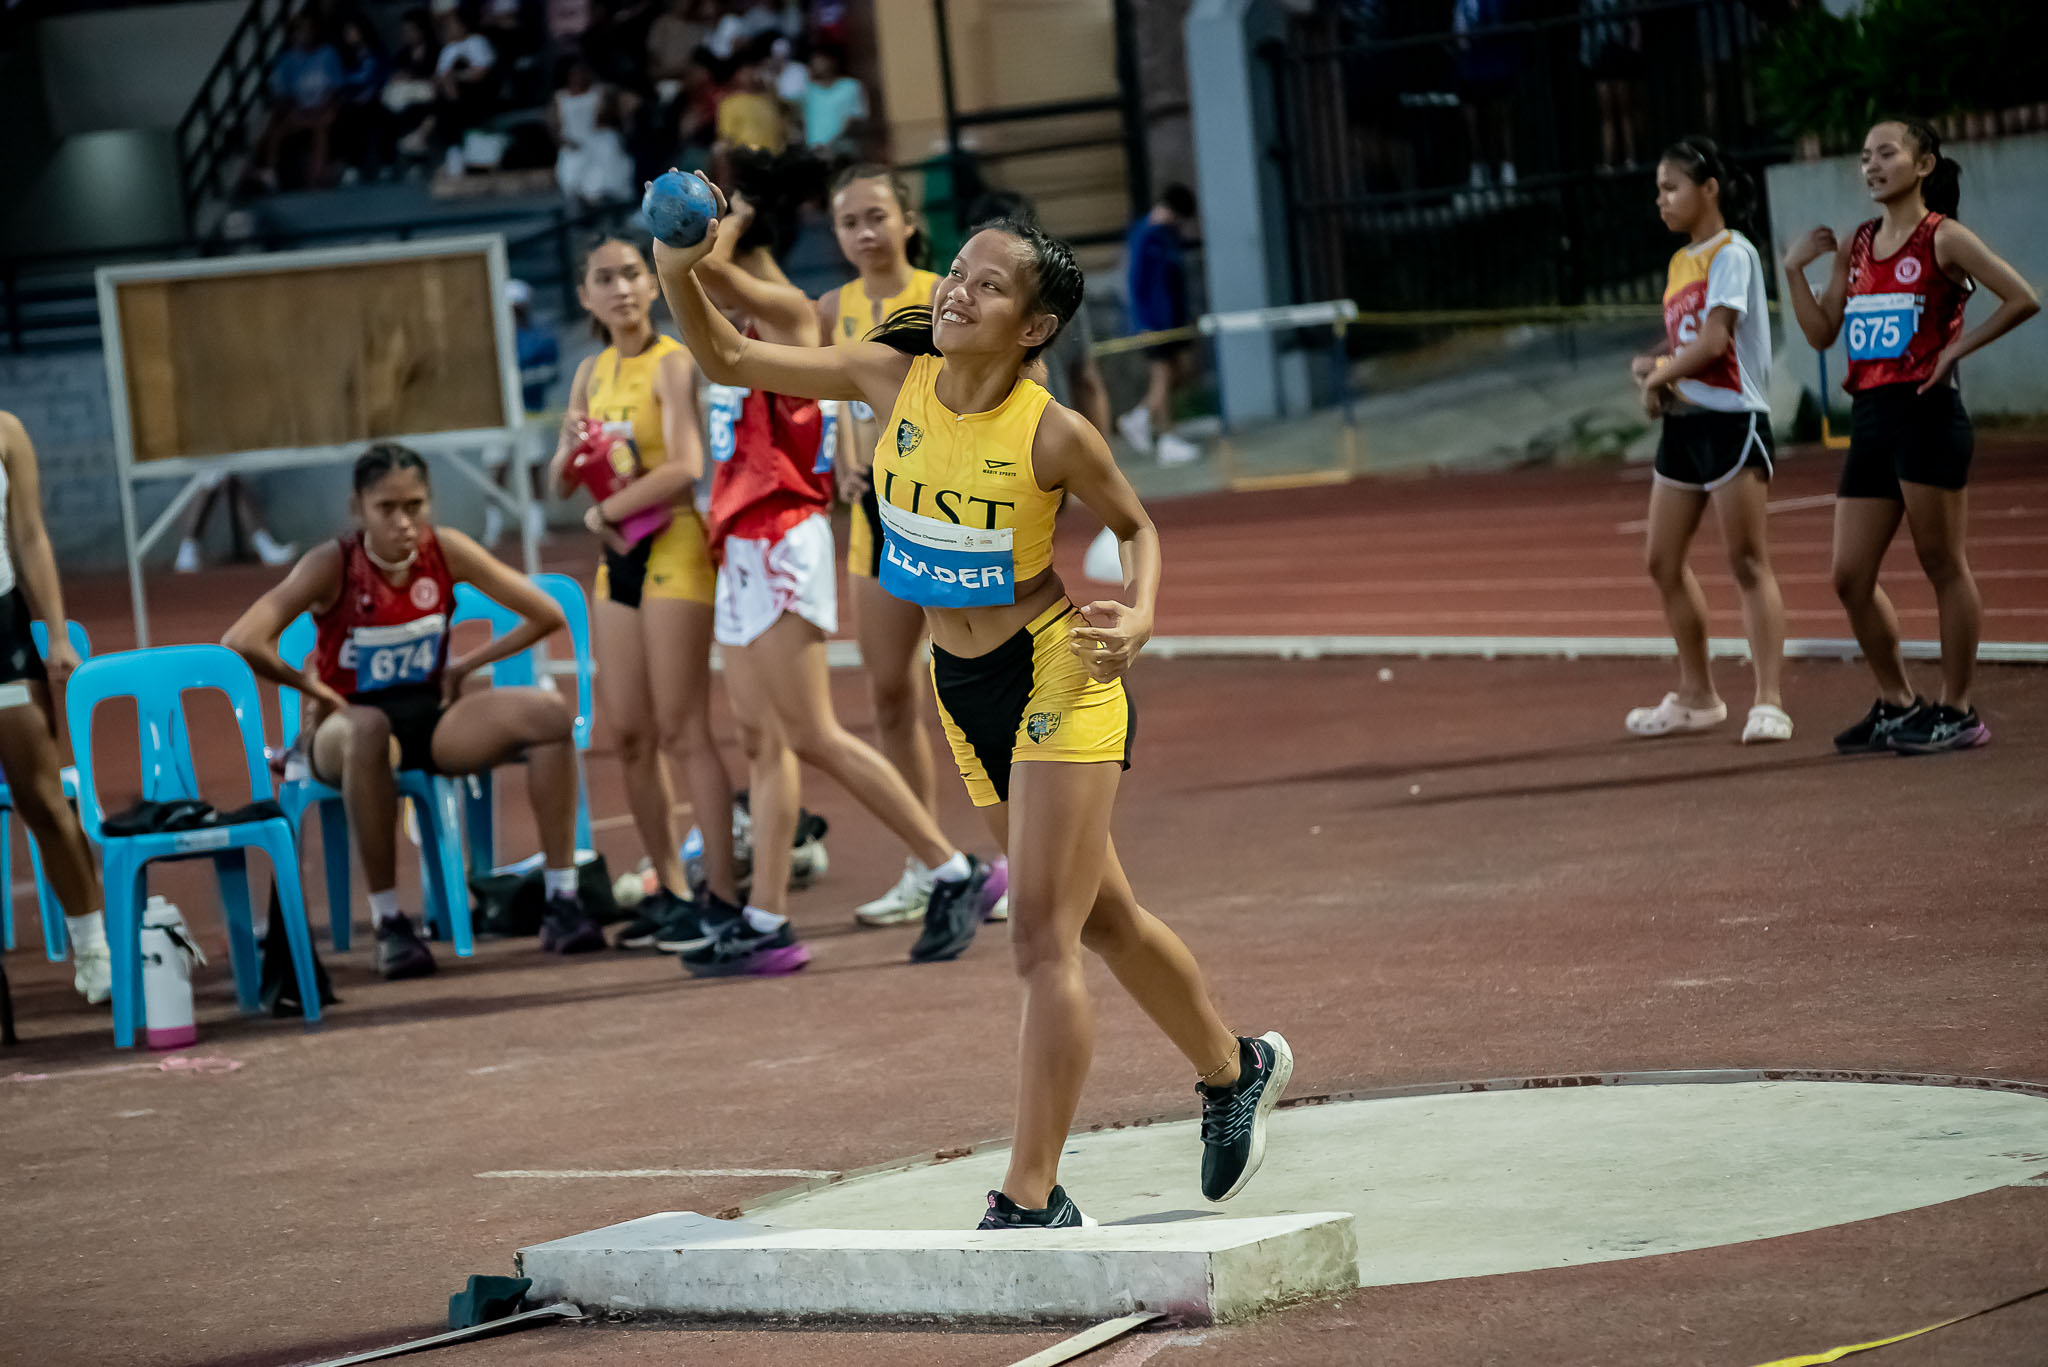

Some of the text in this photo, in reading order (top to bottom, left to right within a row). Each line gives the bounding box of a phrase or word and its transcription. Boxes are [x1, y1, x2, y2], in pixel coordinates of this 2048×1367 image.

[1849, 315, 1900, 351] 675
[884, 468, 1015, 530] UST
[886, 540, 1004, 588] LEADER
[371, 640, 432, 681] 674
